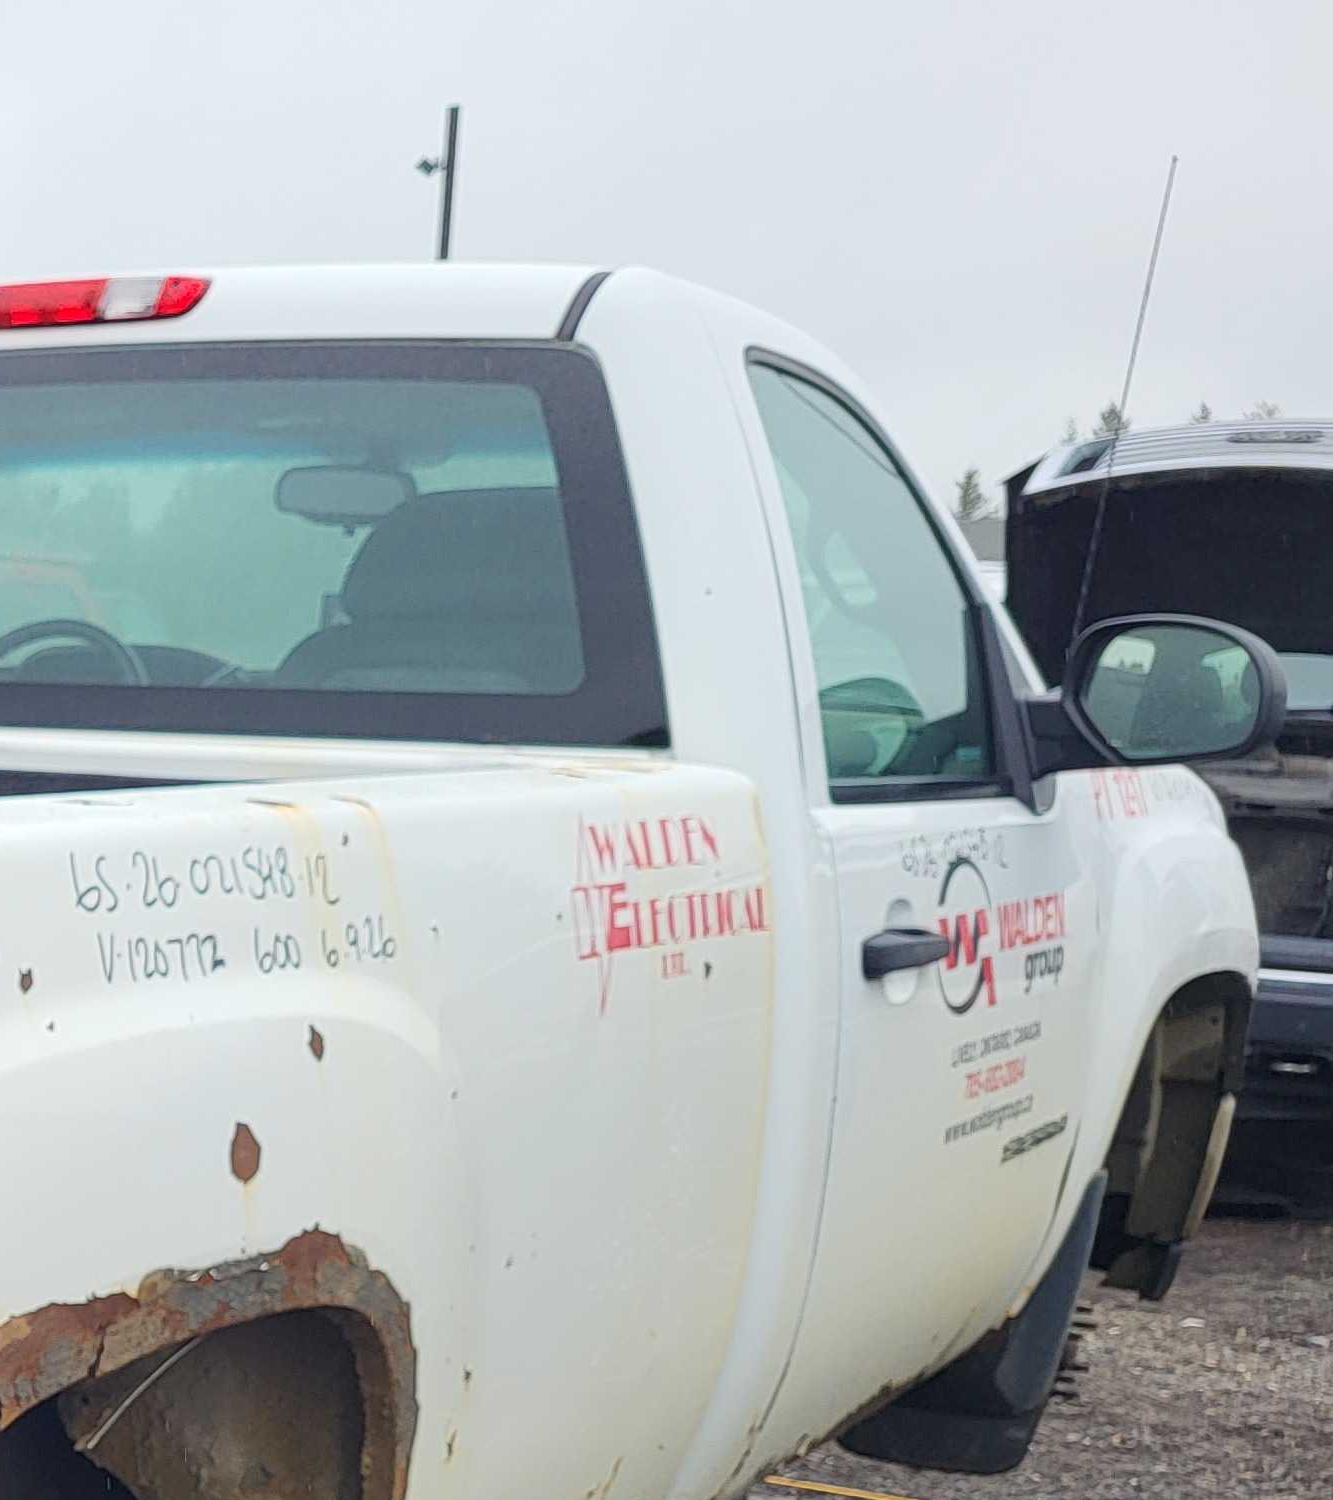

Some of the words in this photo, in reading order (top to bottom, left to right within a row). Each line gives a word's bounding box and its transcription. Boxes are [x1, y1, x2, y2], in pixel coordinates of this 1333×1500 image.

[588, 816, 721, 872] WALDEN
[997, 892, 1065, 951] WALDEN
[1024, 945, 1065, 994] group
